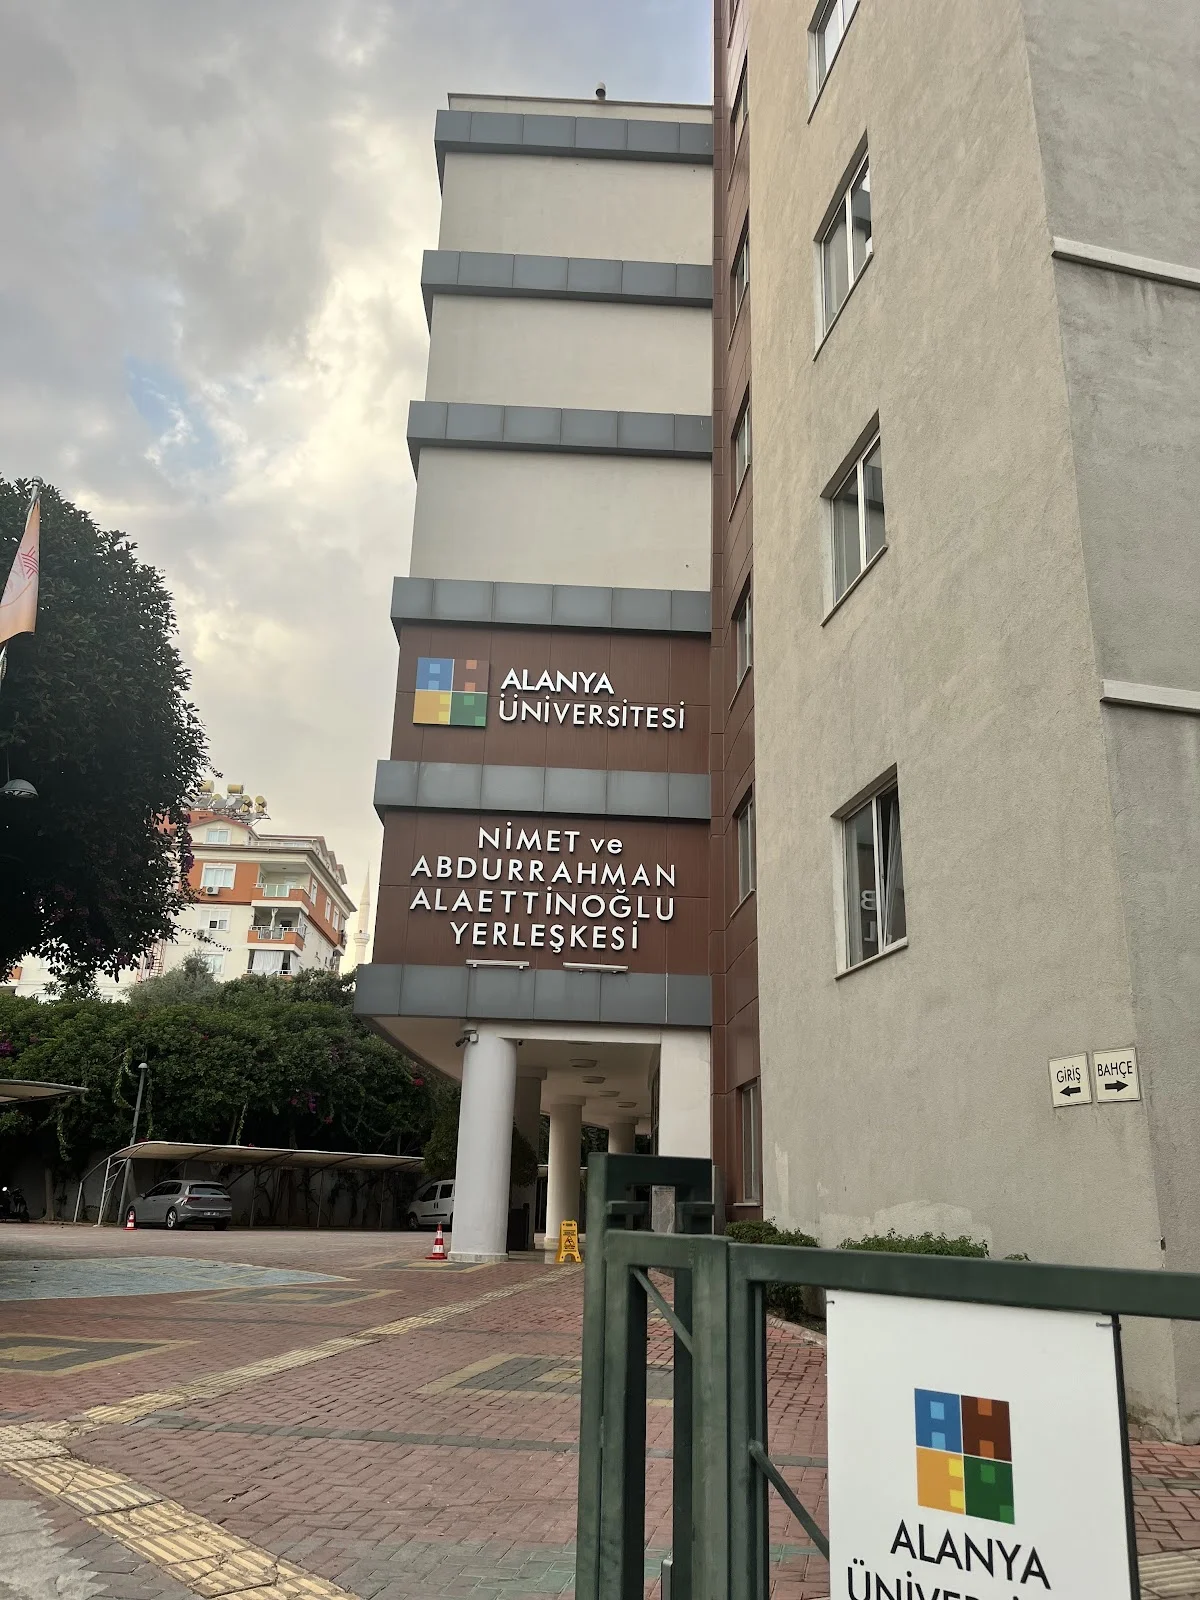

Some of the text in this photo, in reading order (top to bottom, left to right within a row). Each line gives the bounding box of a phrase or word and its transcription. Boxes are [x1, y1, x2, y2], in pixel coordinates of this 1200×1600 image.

[500, 668, 615, 695] ALANYA
[498, 693, 685, 730] ÜNİVERSİTESİ
[478, 821, 623, 855] NİMET ve
[410, 855, 676, 888] ABDURRAHMAN
[409, 886, 675, 921] ALAETTİNOĞLU
[450, 920, 639, 953] YERLEŞKESİ
[1056, 1064, 1081, 1084] GİRİŞ
[1097, 1060, 1133, 1079] BAHÇE
[890, 1518, 1052, 1591] ALANYA
